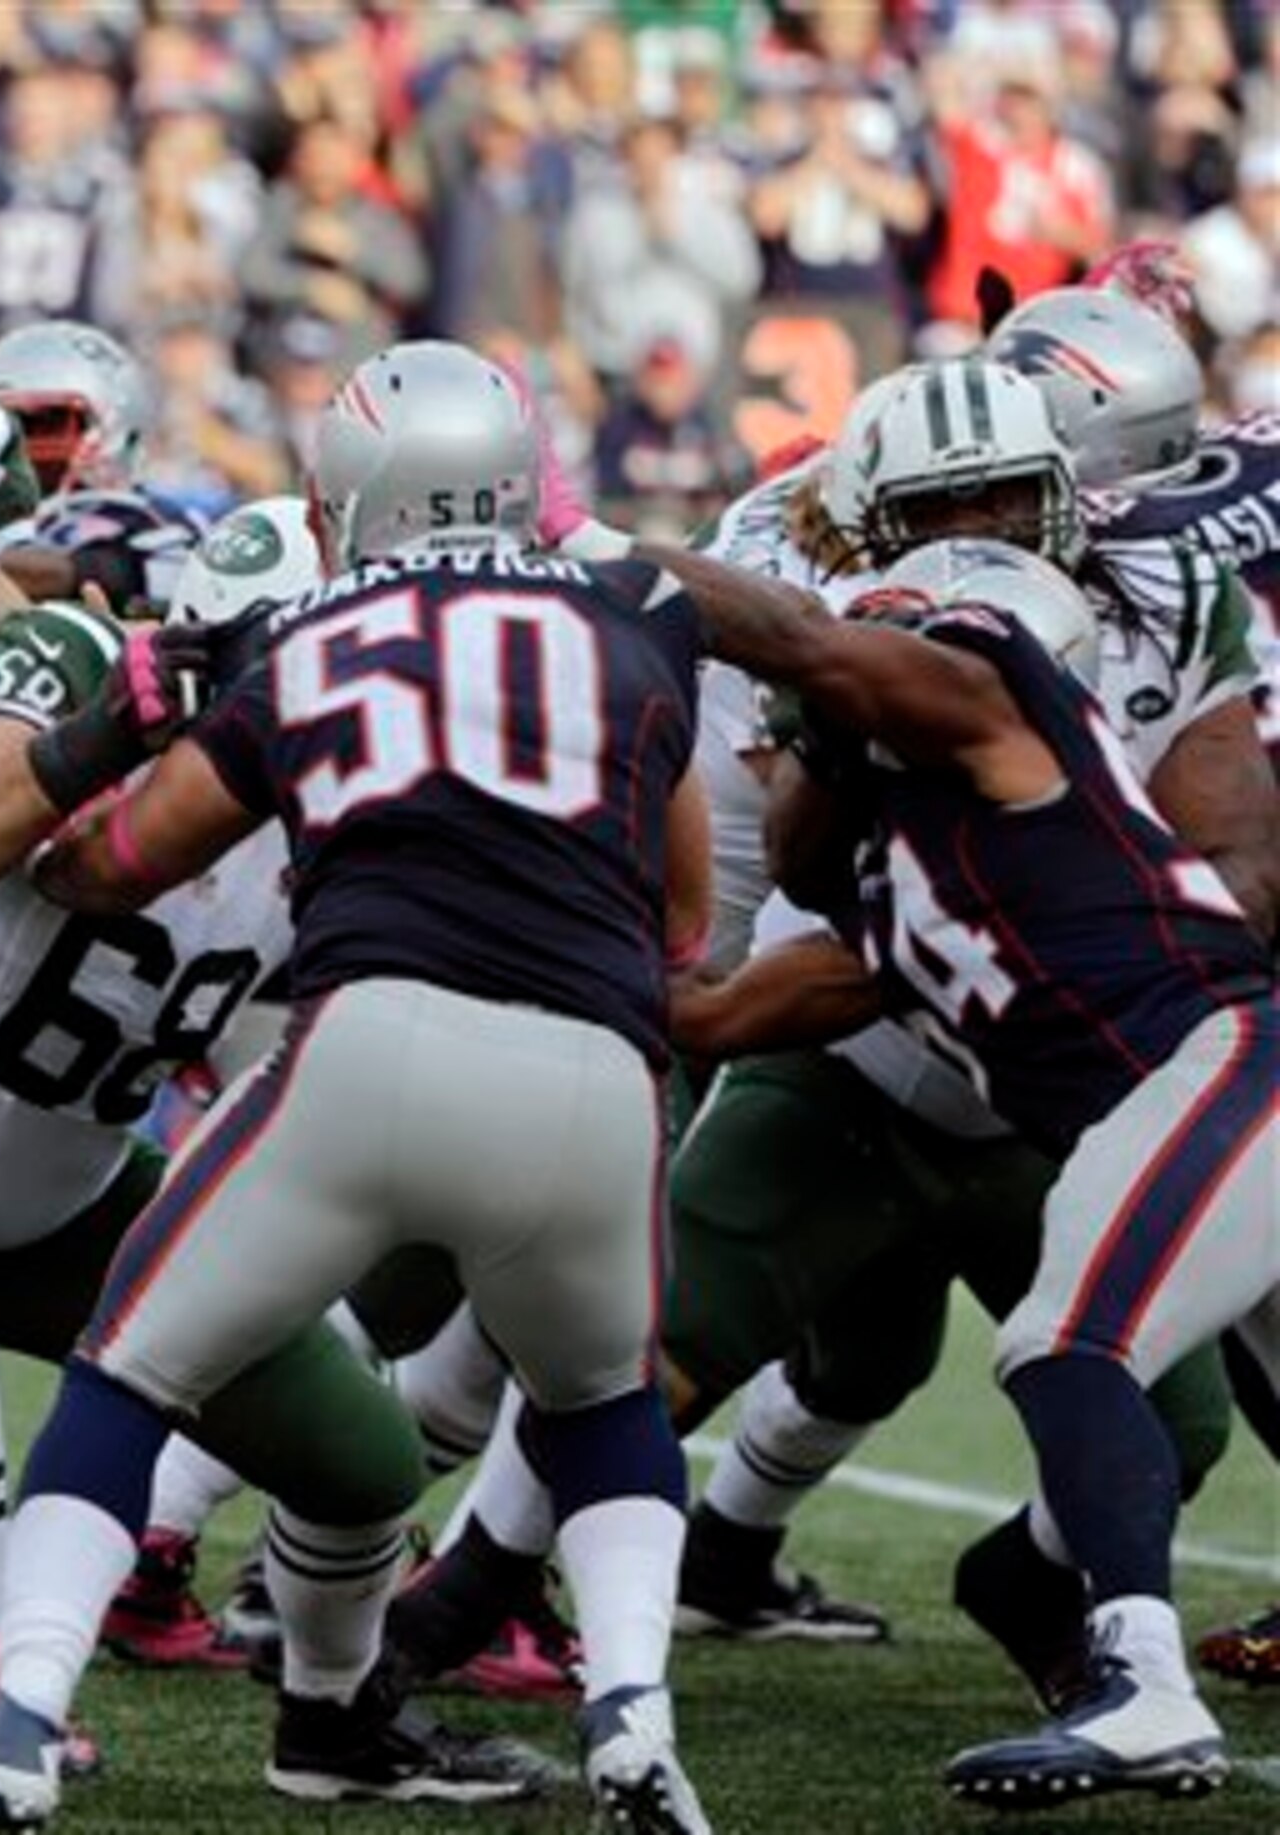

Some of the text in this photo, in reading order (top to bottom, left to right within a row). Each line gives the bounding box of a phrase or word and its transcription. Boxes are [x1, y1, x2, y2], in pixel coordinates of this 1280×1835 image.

[734, 316, 859, 458] 3
[428, 490, 496, 528] 50
[274, 584, 604, 827] 50
